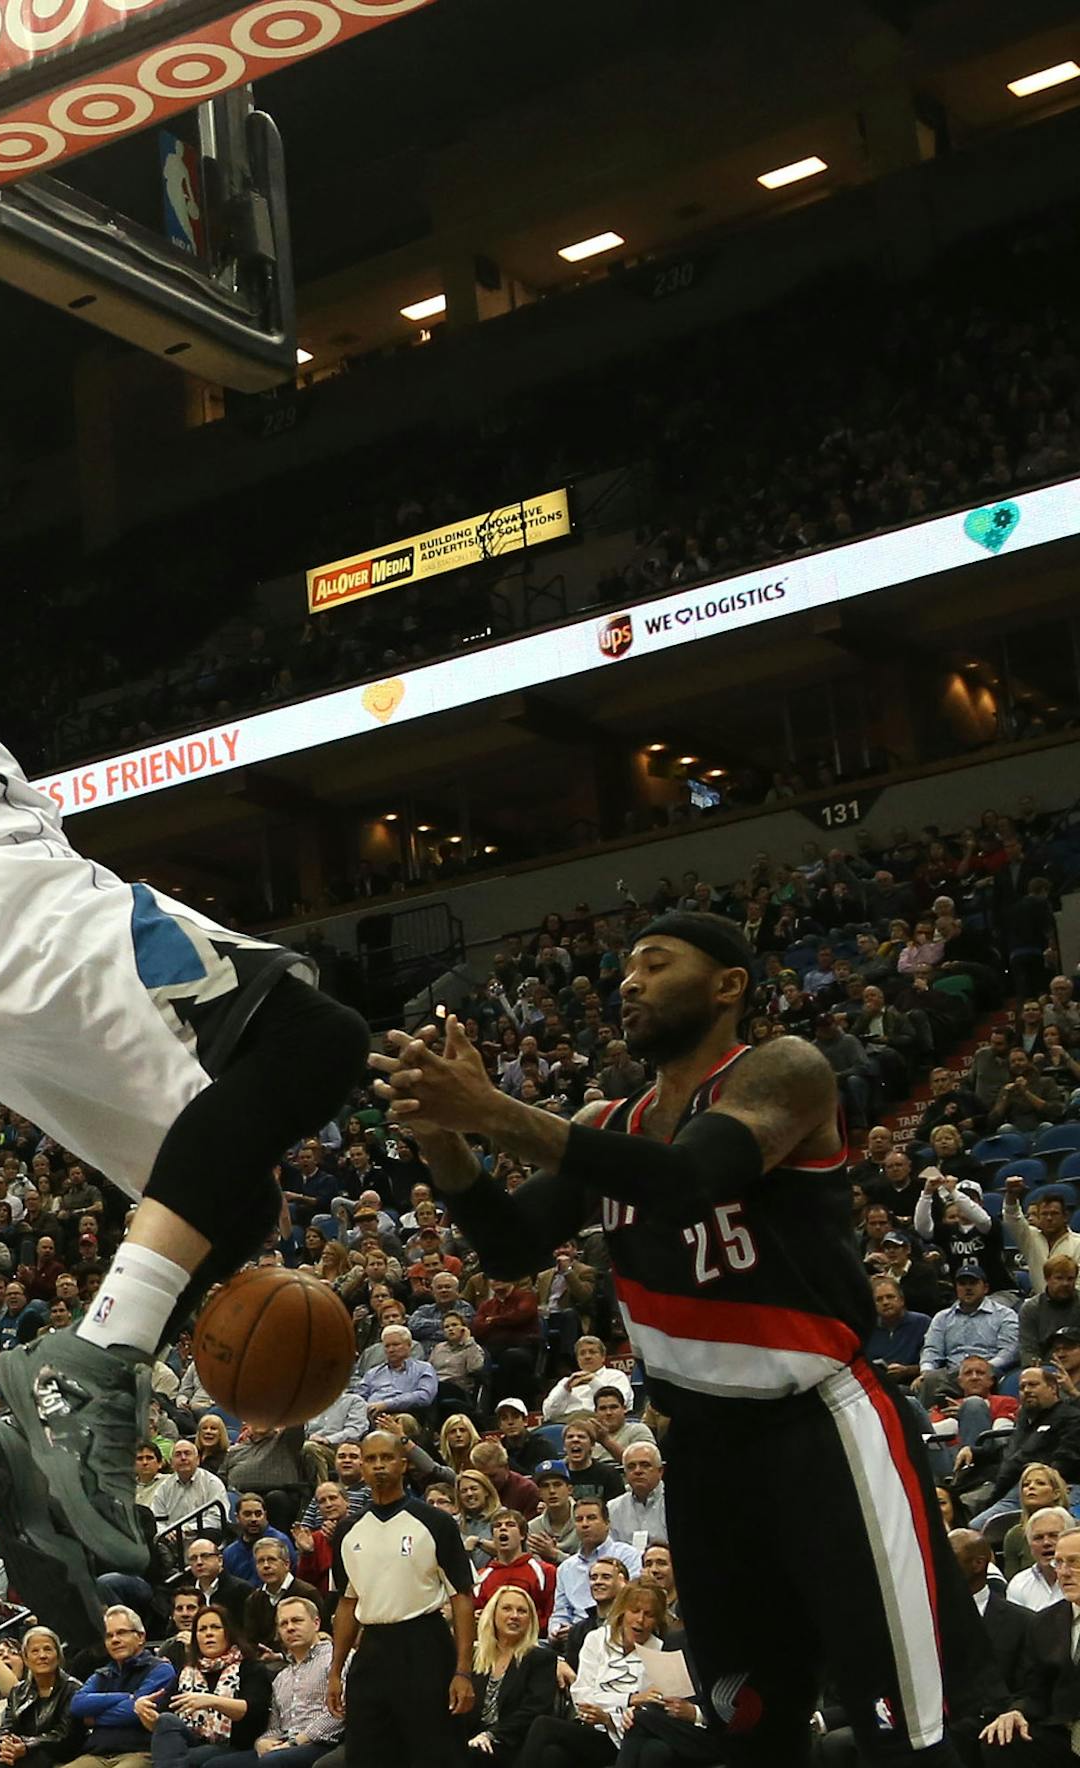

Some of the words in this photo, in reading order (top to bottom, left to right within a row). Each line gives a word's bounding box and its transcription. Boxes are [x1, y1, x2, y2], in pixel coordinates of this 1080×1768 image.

[420, 527, 472, 550] BUILDING
[421, 532, 494, 561] ADVERTISIG
[498, 511, 563, 537] SOLTIONS
[600, 625, 632, 653] ups
[645, 614, 673, 635] WE
[696, 582, 786, 621] LOGISTICS
[73, 772, 97, 805] IS
[106, 729, 239, 796] FRIENDLY
[822, 800, 859, 826] 131
[683, 1203, 756, 1284] 25
